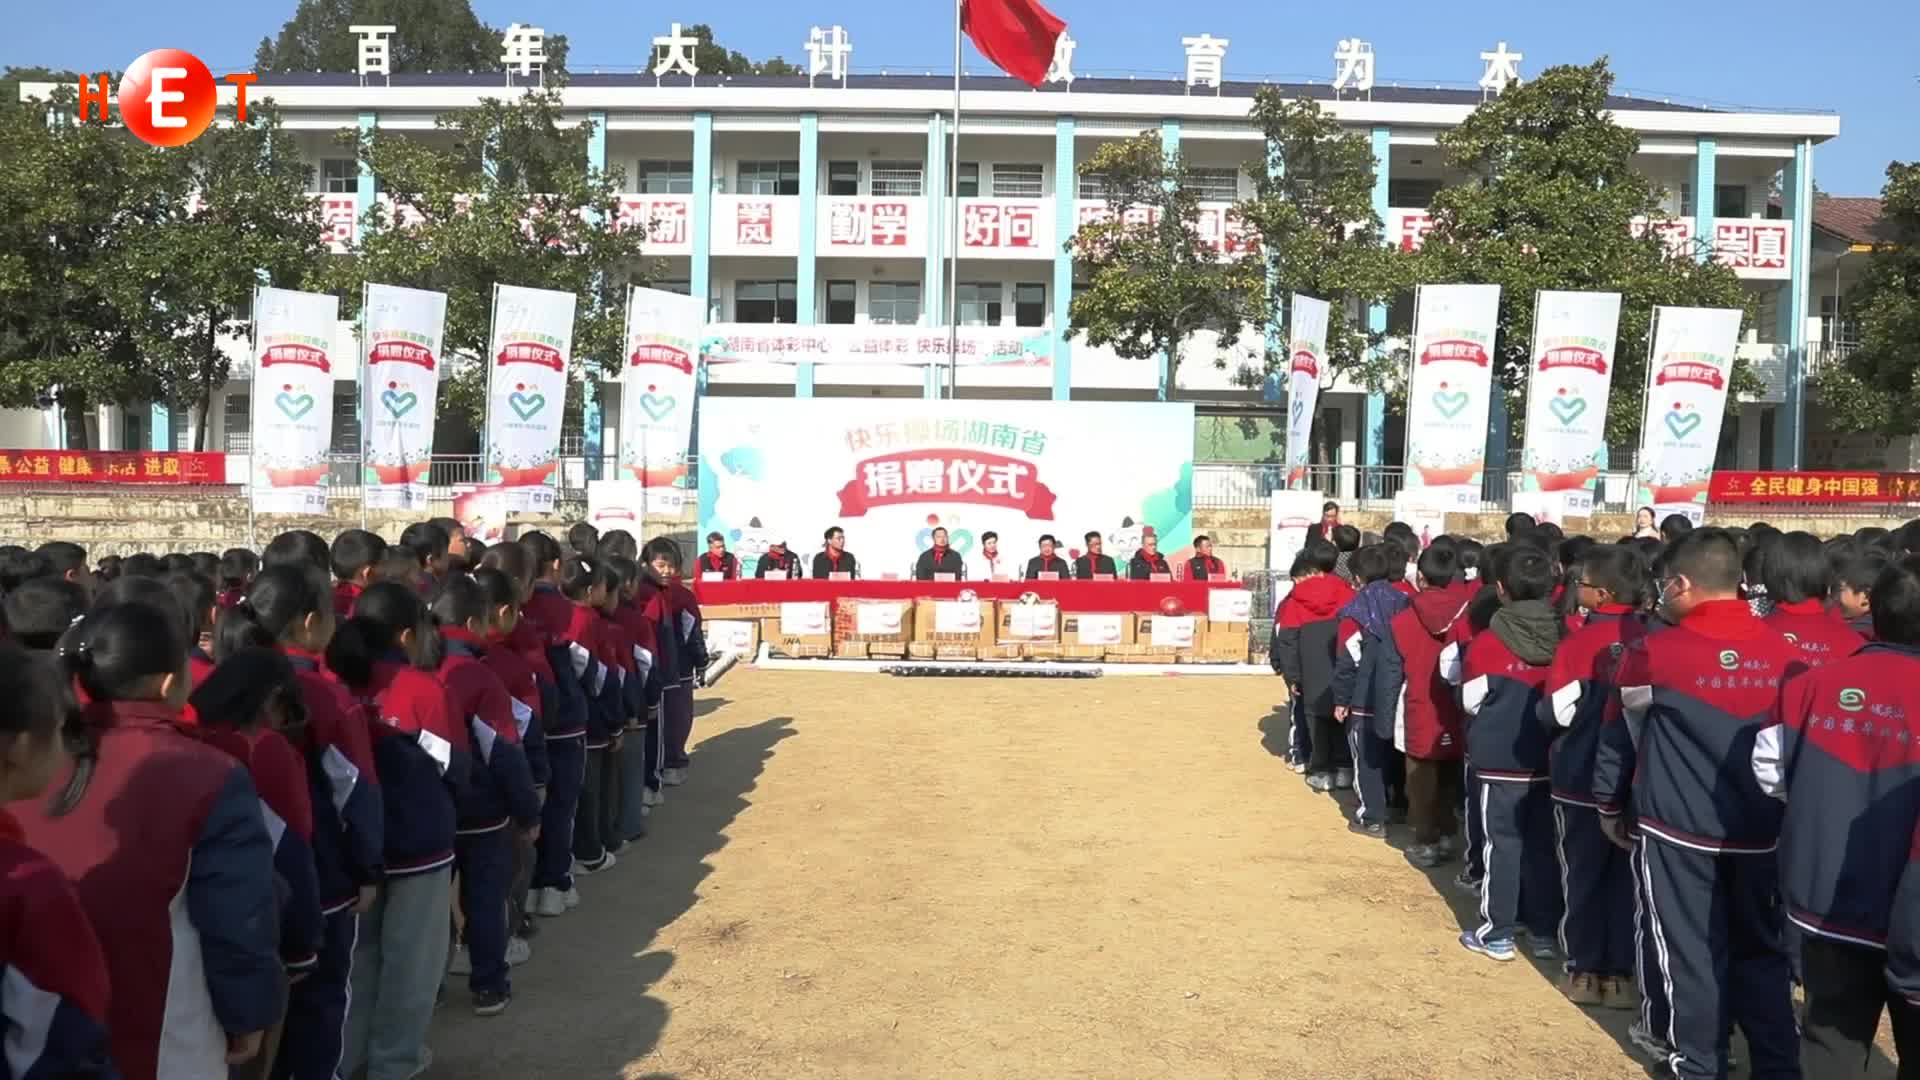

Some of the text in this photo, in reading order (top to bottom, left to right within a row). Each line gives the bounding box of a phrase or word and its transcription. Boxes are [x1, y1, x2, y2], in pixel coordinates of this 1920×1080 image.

[738, 203, 772, 244] 学风
[831, 204, 907, 245] 勤学
[965, 205, 1039, 248] 好问
[1717, 225, 1788, 269] 崇真
[844, 417, 1048, 456] 快乐操场湖南省
[15, 456, 49, 475] 公益
[58, 456, 93, 476] 健康
[144, 457, 179, 476] 进取
[863, 459, 1028, 499] 捐赠仪式
[1751, 477, 1879, 497] 全民健身中国强
